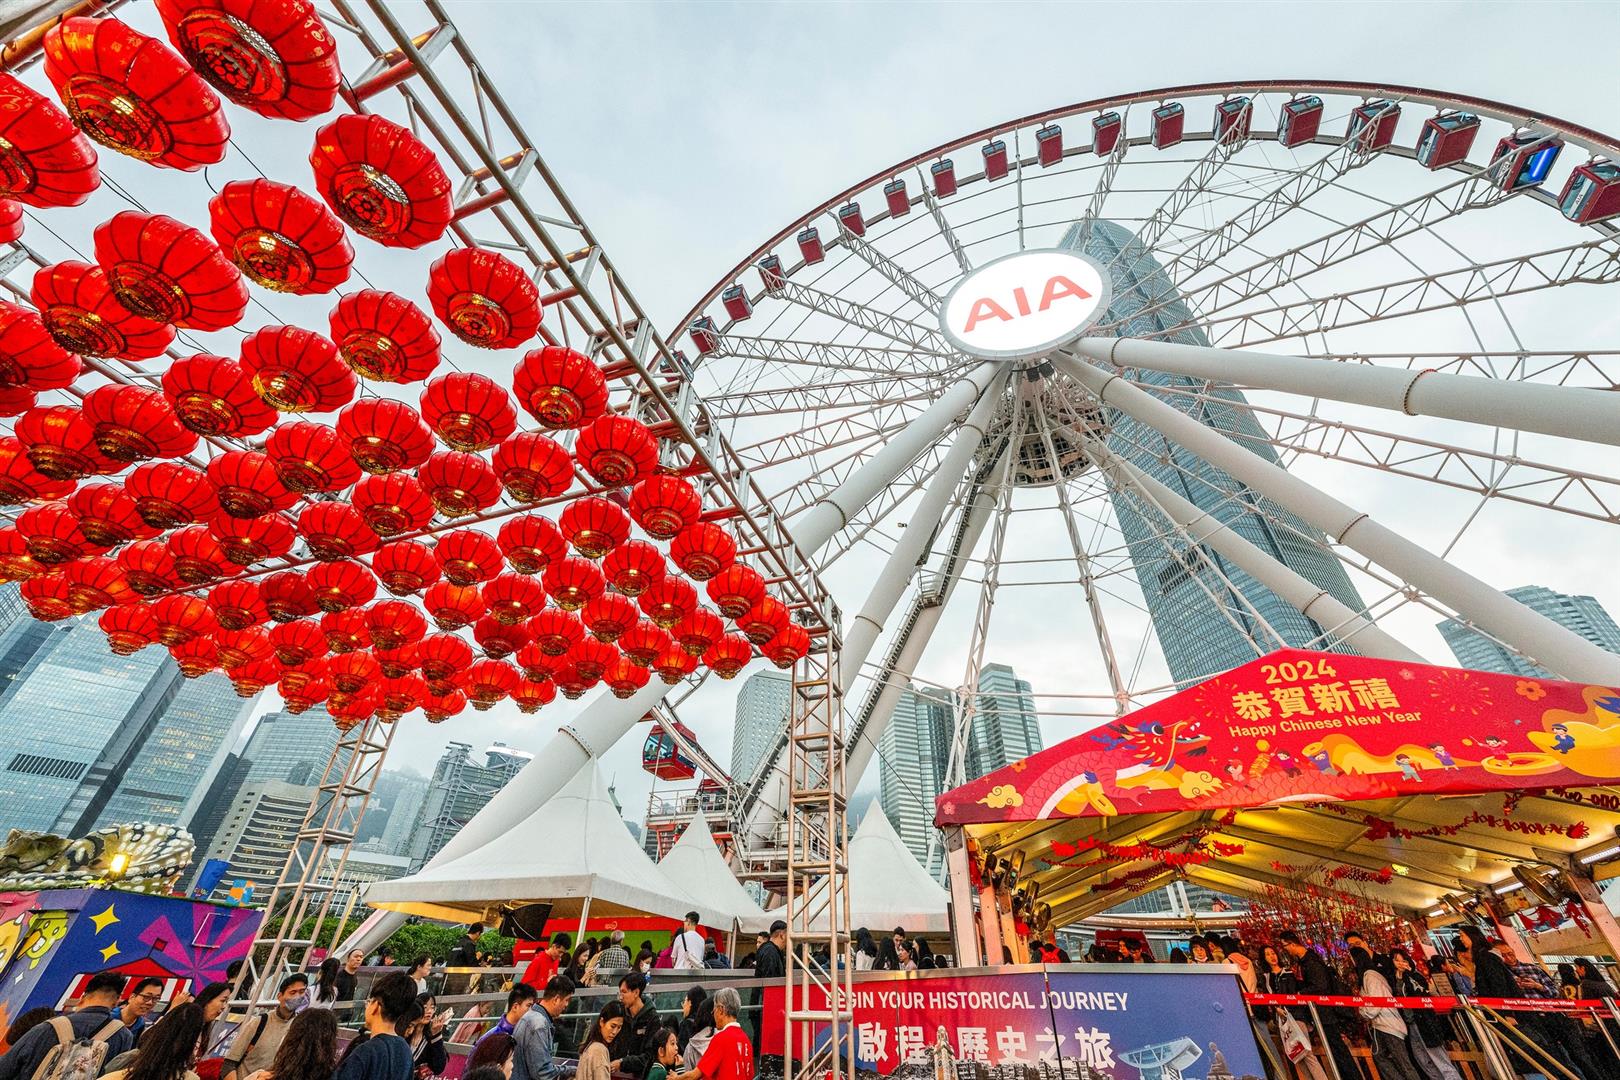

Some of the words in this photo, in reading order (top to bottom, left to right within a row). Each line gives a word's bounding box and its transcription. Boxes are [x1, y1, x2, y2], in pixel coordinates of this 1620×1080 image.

[963, 275, 1093, 333] AIA
[1260, 658, 1337, 685] 2024
[1231, 677, 1401, 722] 恭賀新禧
[1229, 722, 1277, 738] Happy
[1280, 717, 1343, 733] Chinese
[1344, 714, 1382, 727] New
[1383, 710, 1422, 723] Year
[877, 991, 925, 1009] YOUR
[929, 991, 1035, 1009] HISTORICAL
[1040, 991, 1128, 1011] JOURNEY
